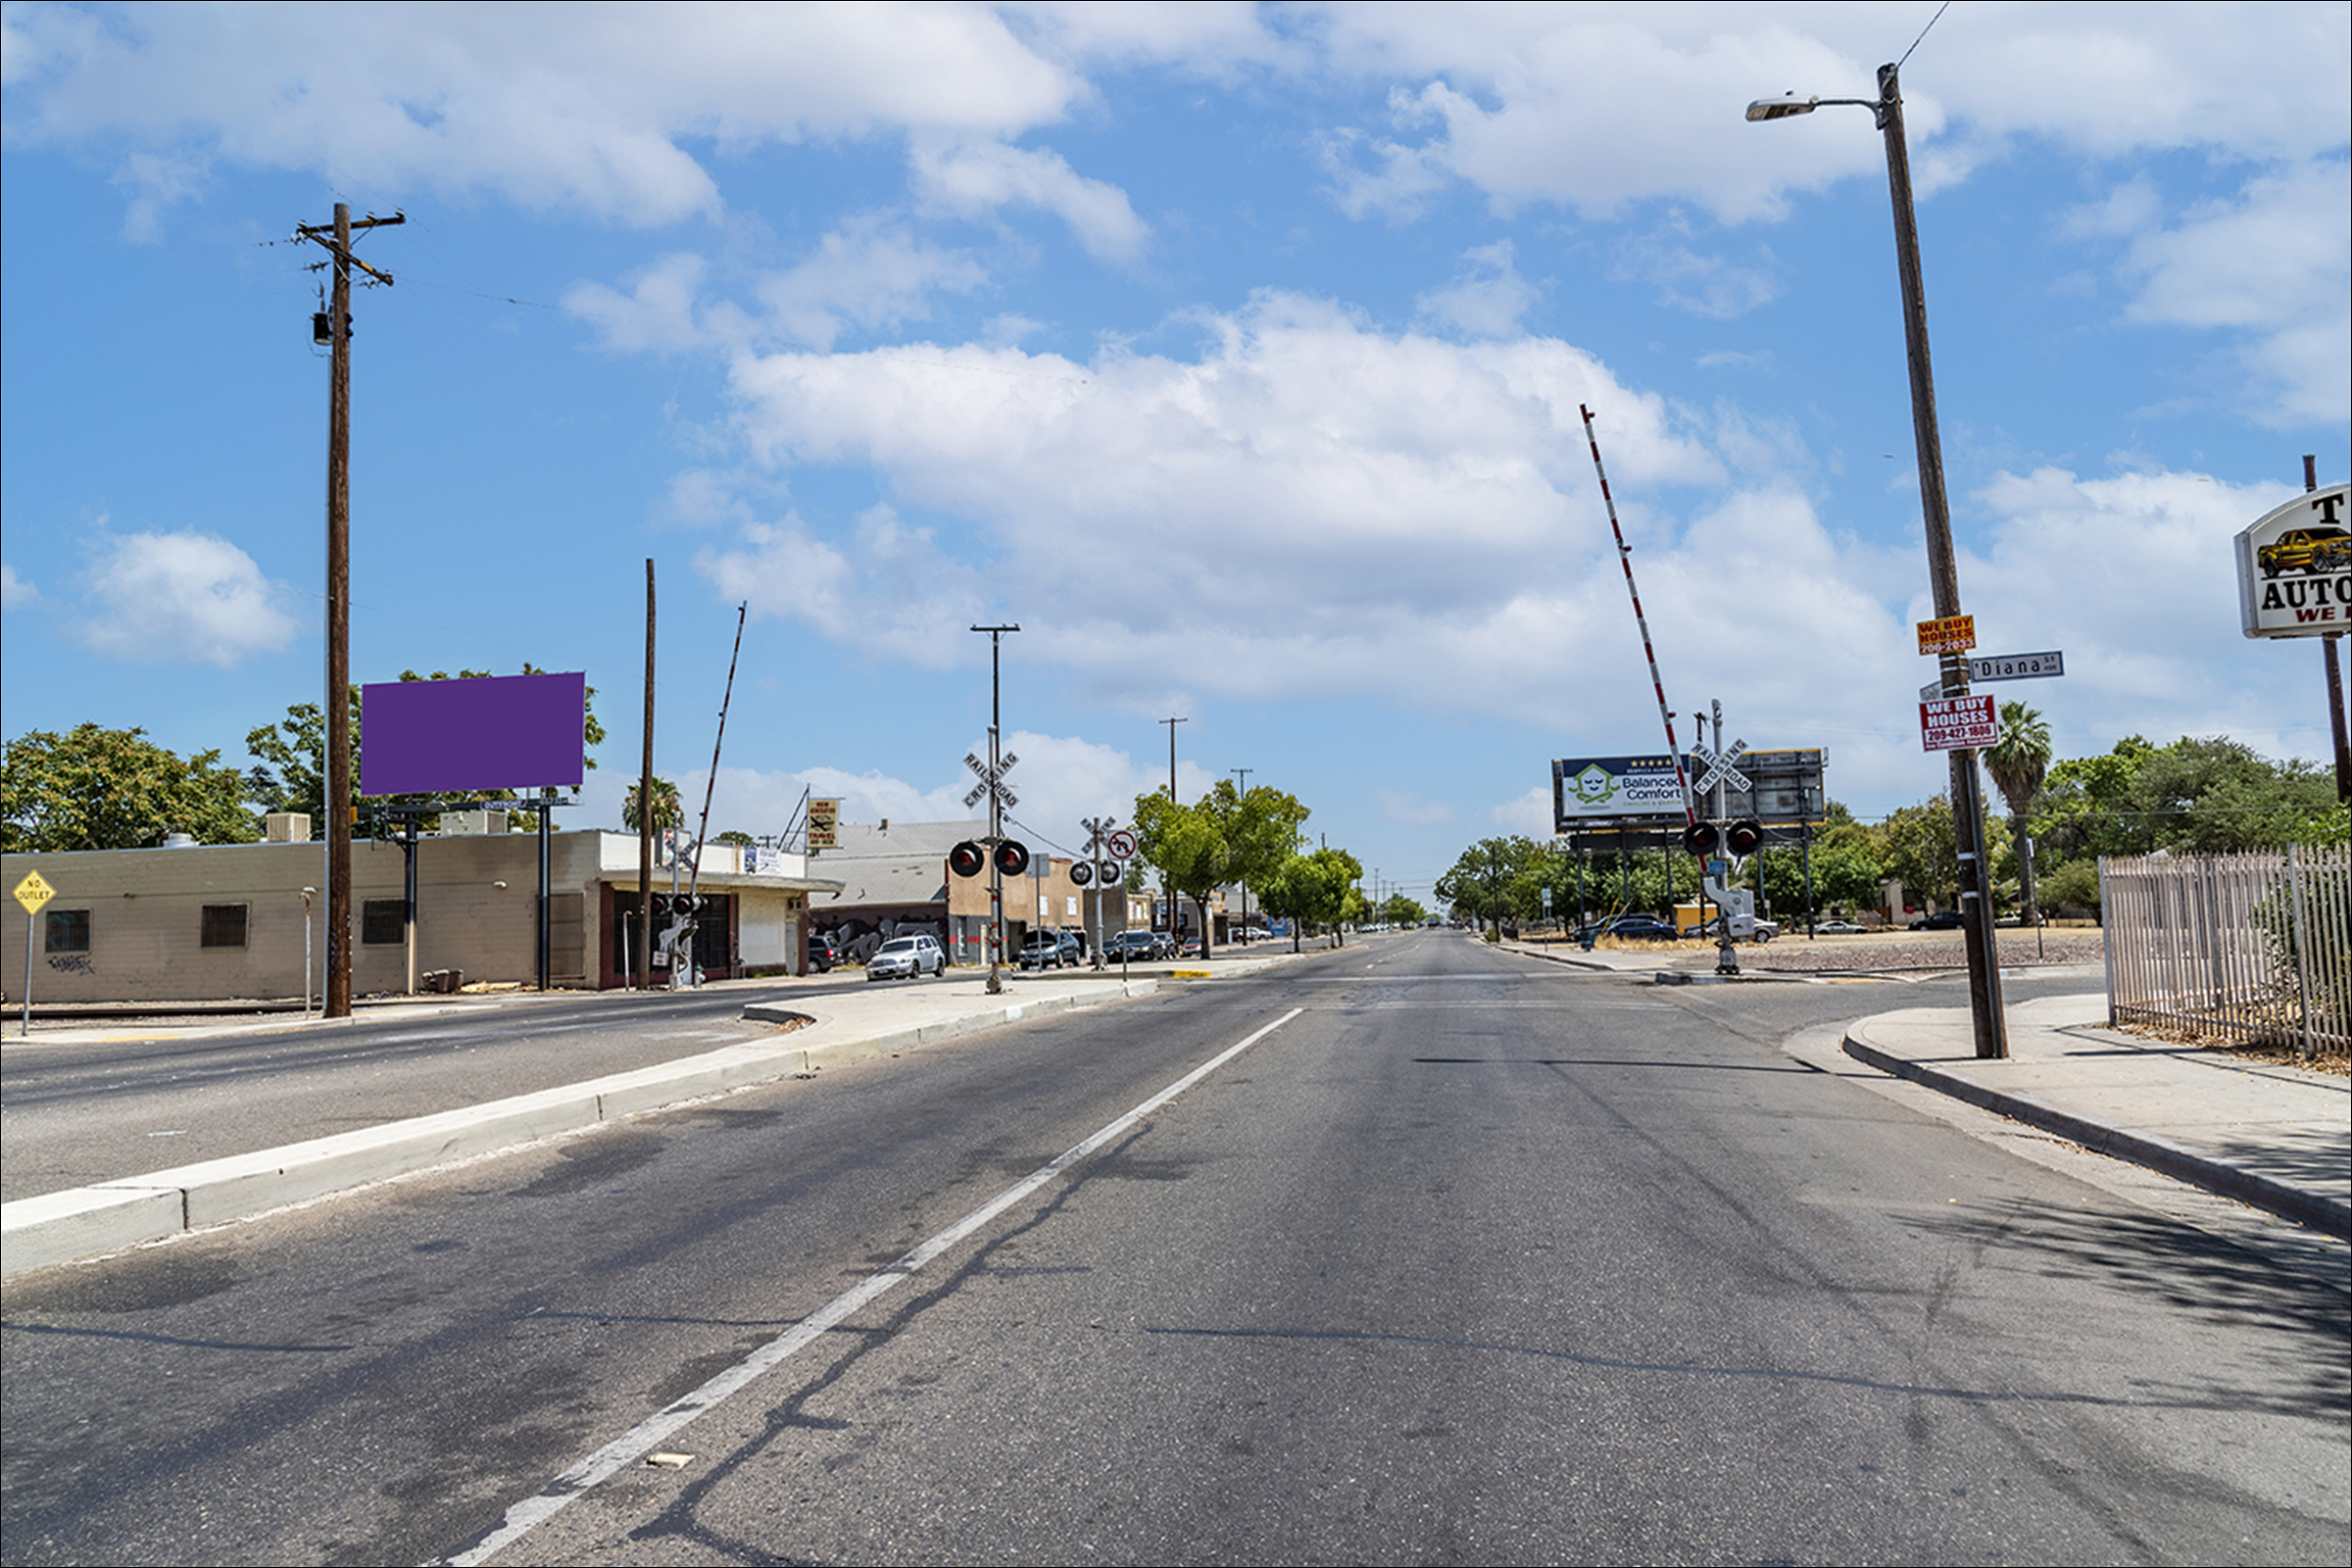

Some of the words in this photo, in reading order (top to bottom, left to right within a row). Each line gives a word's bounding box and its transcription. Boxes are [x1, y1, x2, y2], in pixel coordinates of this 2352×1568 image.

[2312, 493, 2344, 524] T
[2261, 575, 2351, 610] AUTO
[2295, 607, 2336, 623] WE
[1921, 621, 1941, 633] WE
[1944, 616, 1971, 629] BUY
[1921, 627, 1973, 642] HOUSES
[1982, 660, 2039, 676] Diana
[1926, 701, 1951, 714] WE
[1955, 697, 1986, 711] BUY
[1928, 710, 1988, 727] HOUSES
[1627, 788, 1681, 800] Comfort
[27, 879, 41, 888] NO
[19, 891, 50, 900] OUTLET
